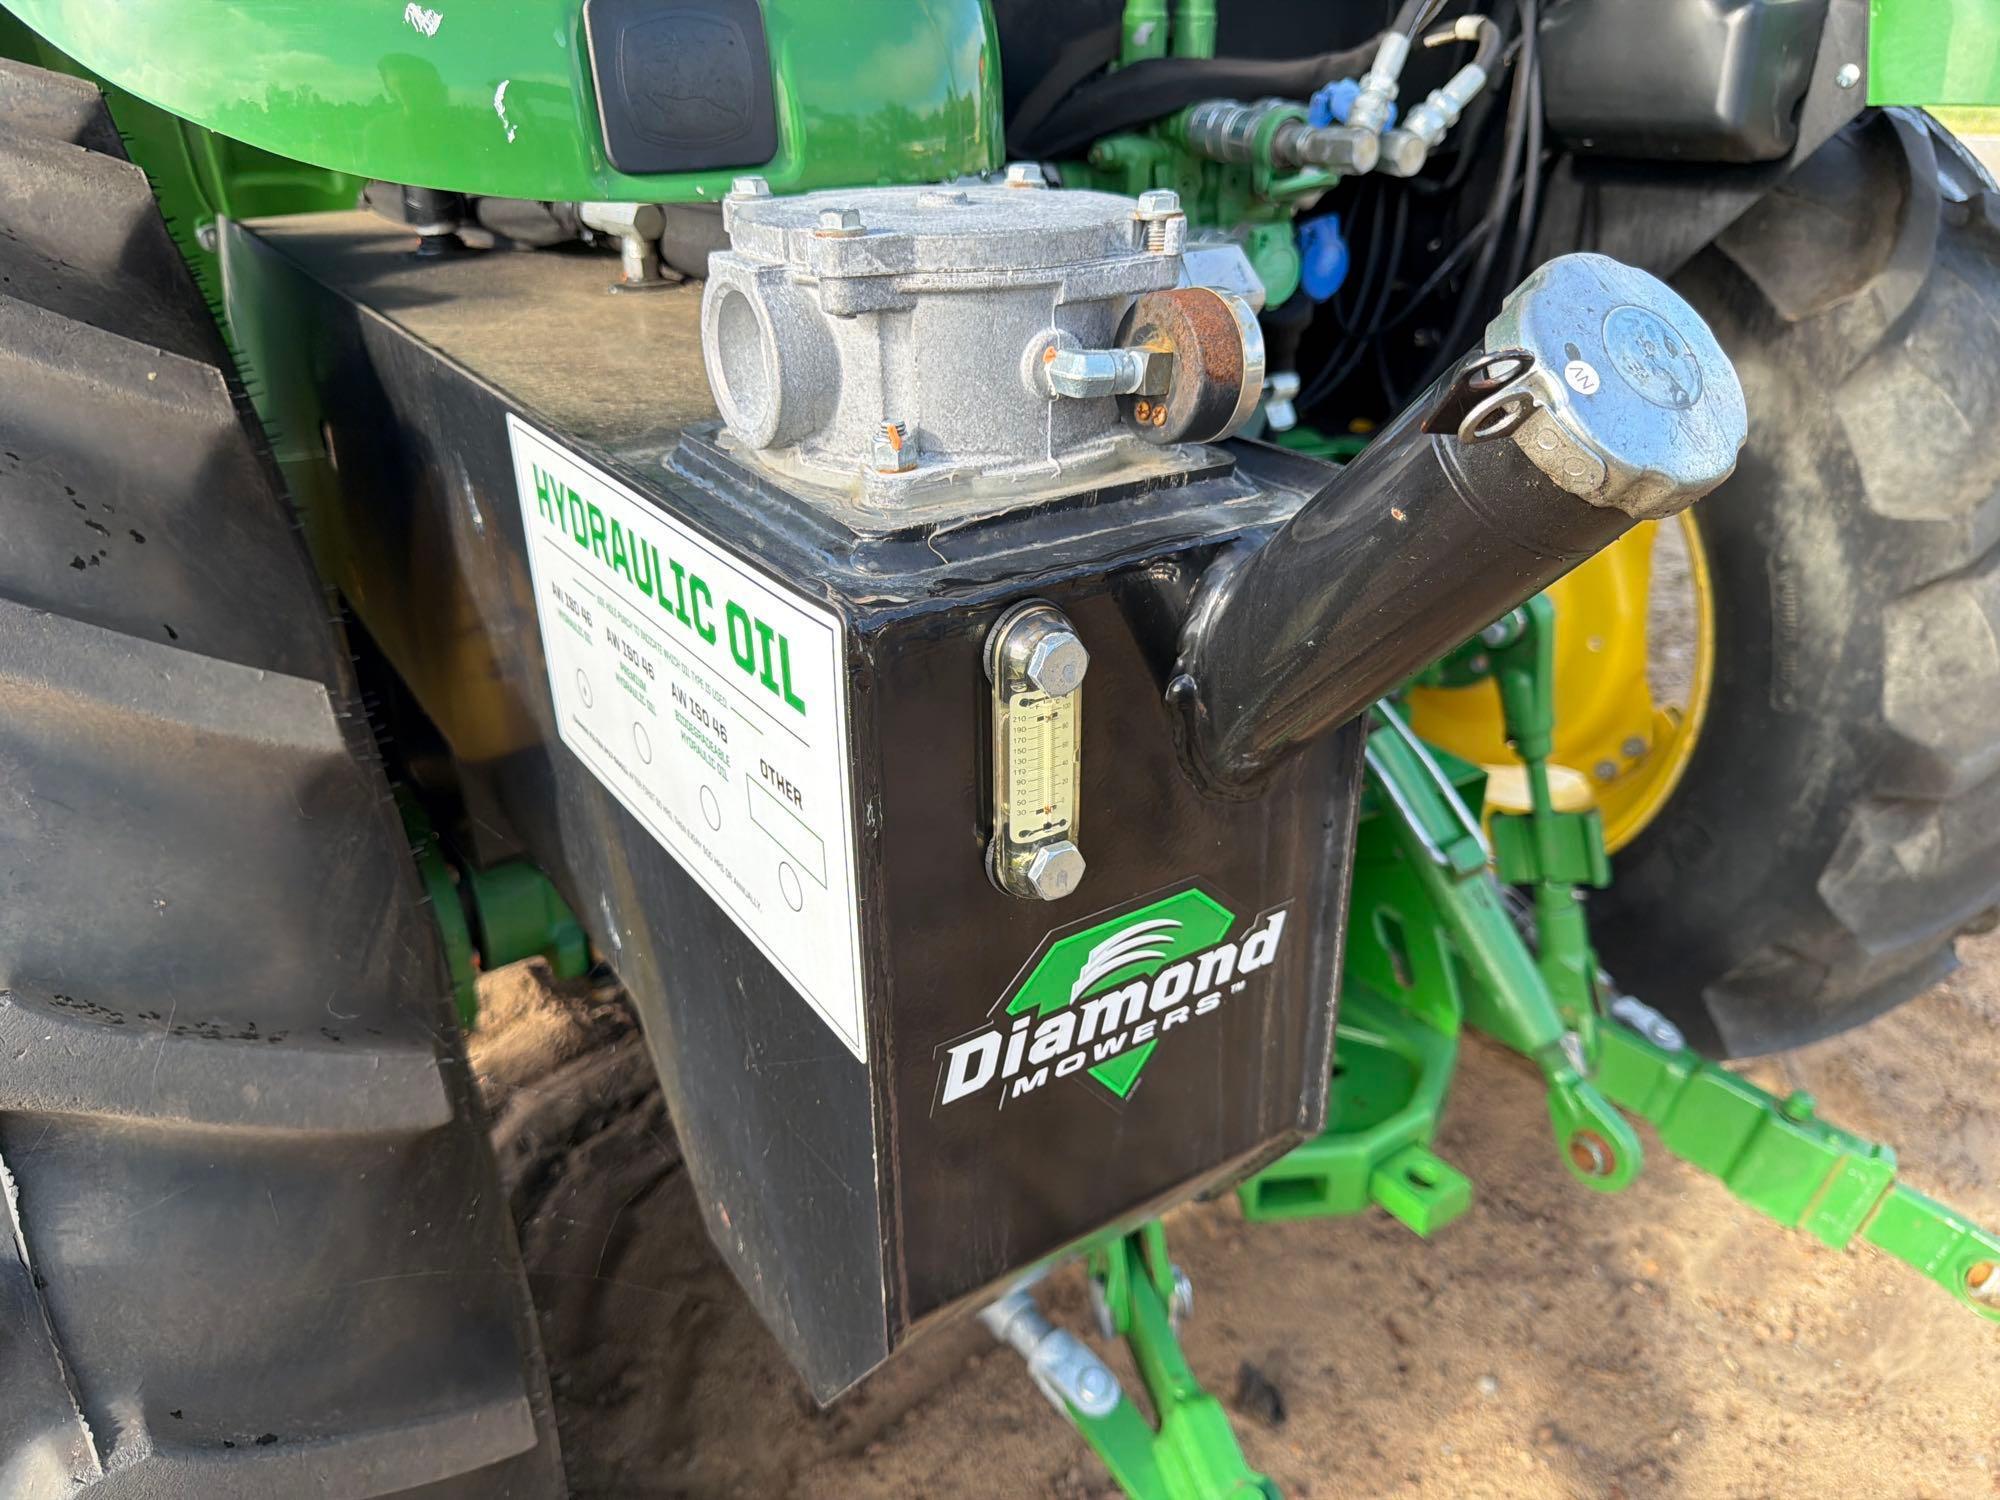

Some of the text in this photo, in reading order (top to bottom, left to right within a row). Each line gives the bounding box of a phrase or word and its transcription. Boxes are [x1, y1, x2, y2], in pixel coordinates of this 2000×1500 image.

[532, 462, 807, 717] HYDRAULIC OIL
[581, 605, 593, 628] 46
[606, 626, 655, 681] AW ISO 46
[690, 670, 705, 690] TYPE
[671, 681, 728, 745] AW ISO 46
[1013, 715, 1027, 723] 210
[1013, 726, 1027, 734] 190
[680, 729, 729, 782] HYDRAULIC OIL
[1013, 747, 1027, 755] 150
[759, 757, 804, 811] OTHER
[1016, 778, 1027, 786] 90
[942, 909, 1287, 1105] Diamond
[1011, 991, 1223, 1098] MOWERS
